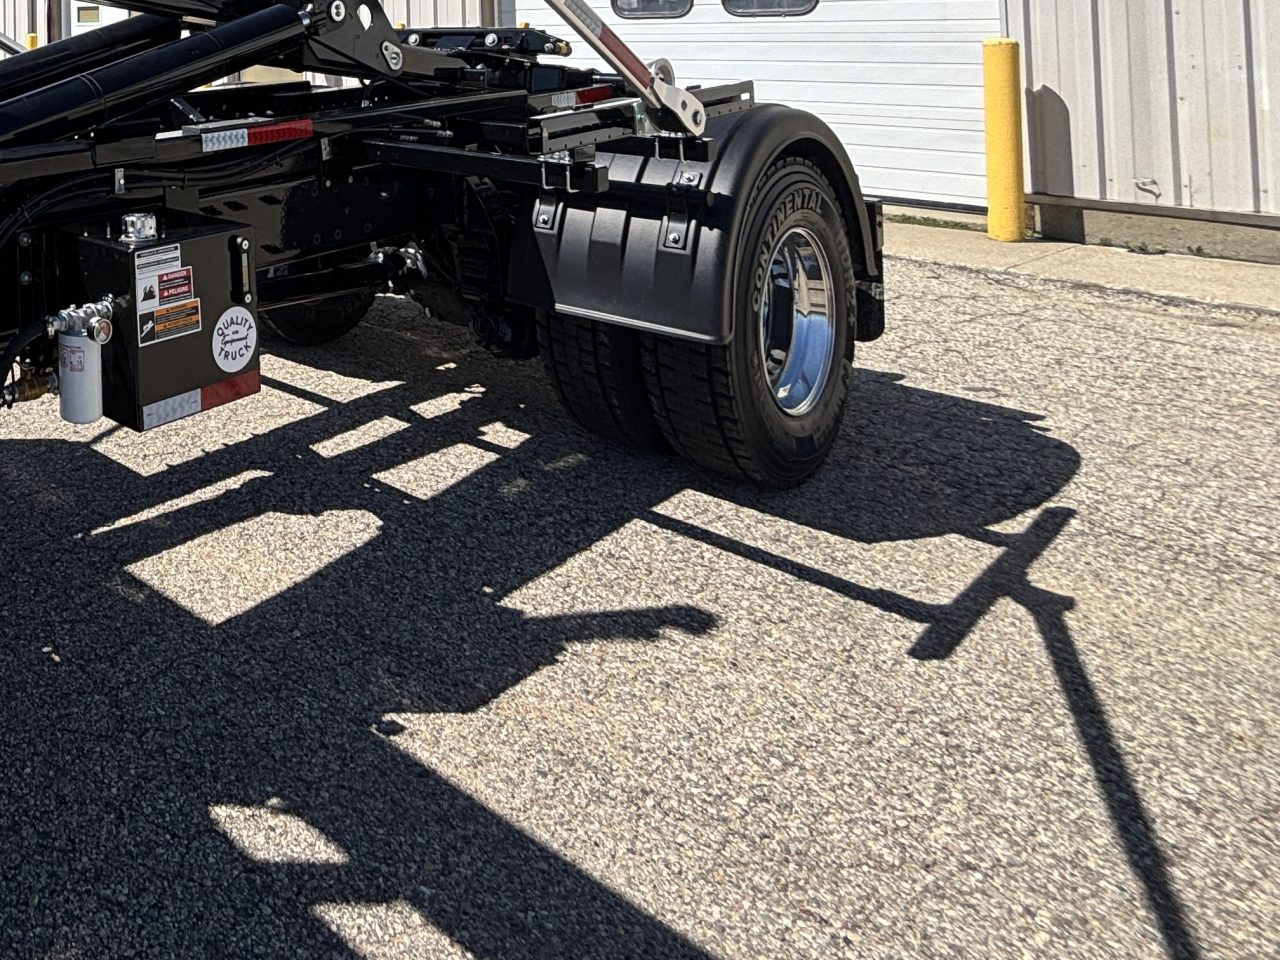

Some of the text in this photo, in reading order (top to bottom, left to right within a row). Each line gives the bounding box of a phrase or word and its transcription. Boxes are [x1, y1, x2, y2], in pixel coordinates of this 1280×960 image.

[751, 186, 822, 313] CONTINENTAL
[216, 315, 254, 337] QUALITY
[218, 340, 252, 361] TRUCK
